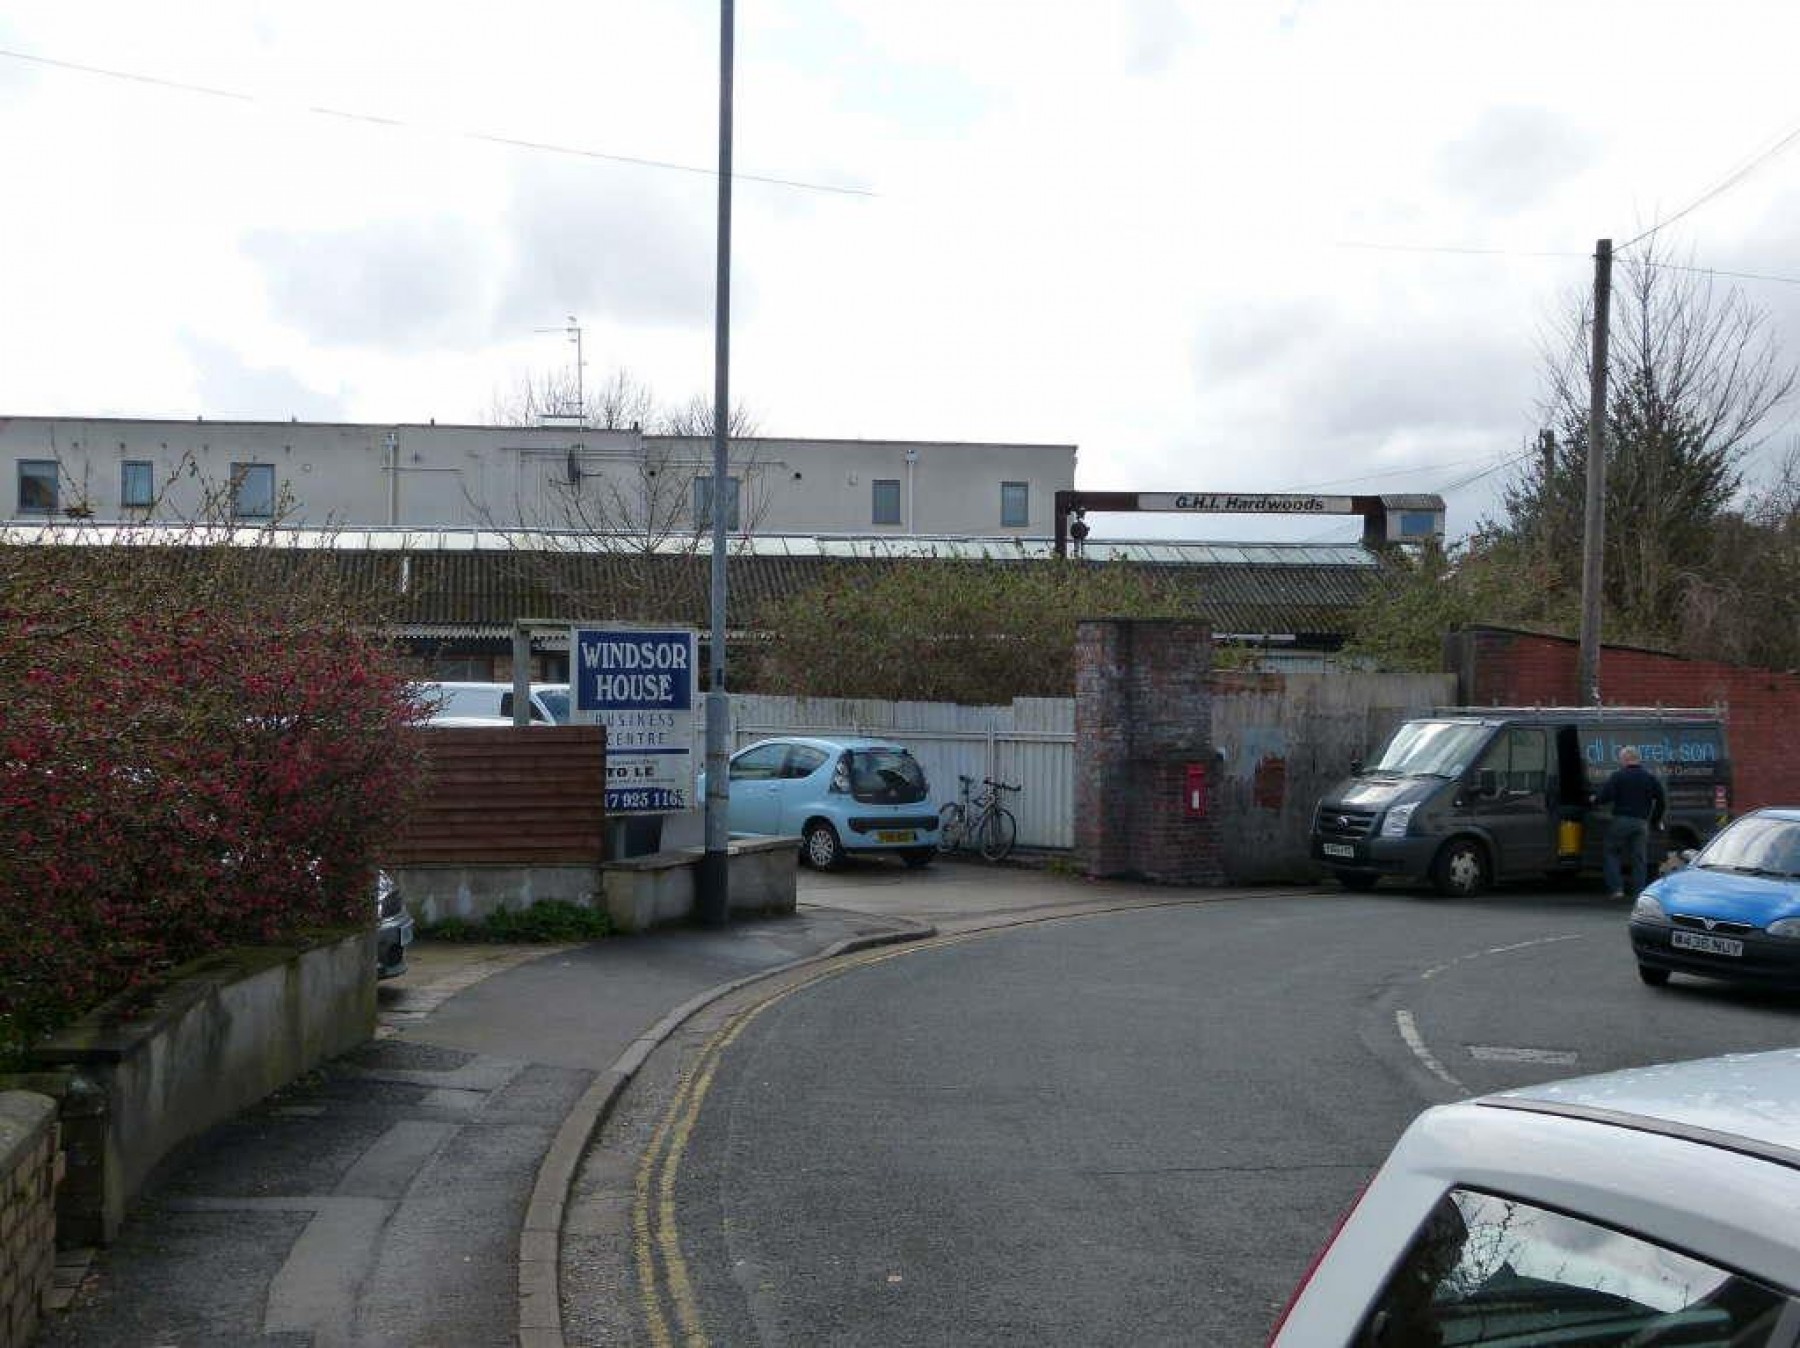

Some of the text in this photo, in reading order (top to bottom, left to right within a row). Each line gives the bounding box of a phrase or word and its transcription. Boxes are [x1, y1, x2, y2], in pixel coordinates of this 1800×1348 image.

[1225, 496, 1324, 511] Hardwoods
[581, 642, 687, 669] WINDSOR
[595, 674, 674, 701] HOUSE
[595, 712, 675, 727] BUSINESS
[606, 732, 668, 746] CENTRE
